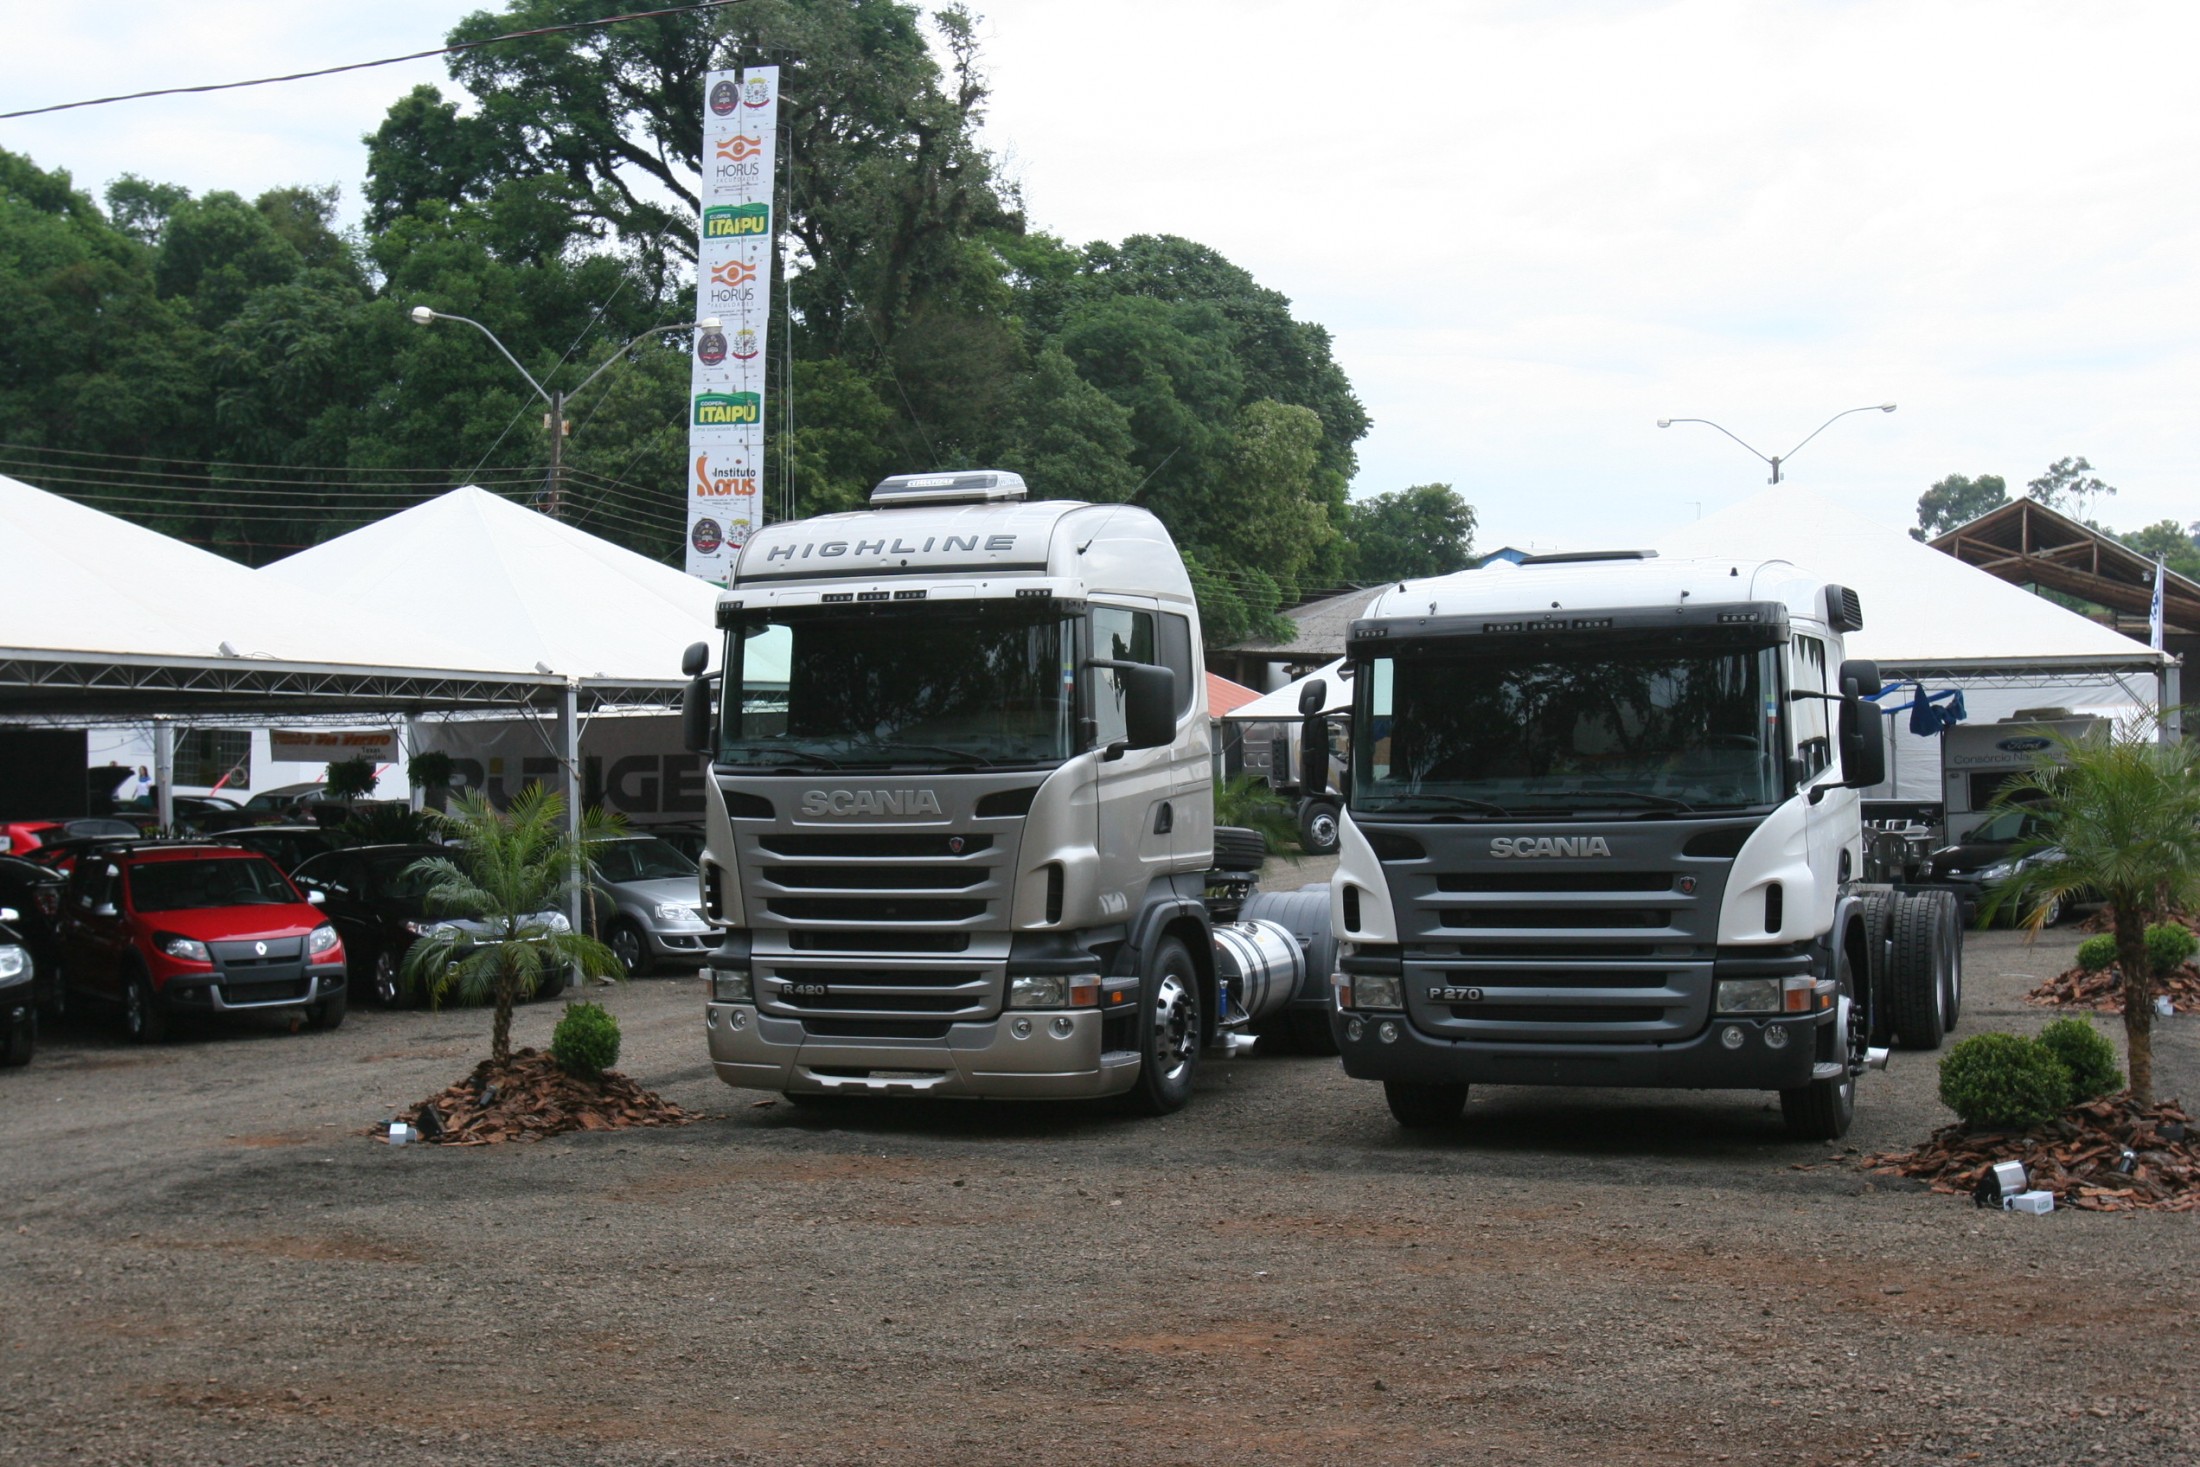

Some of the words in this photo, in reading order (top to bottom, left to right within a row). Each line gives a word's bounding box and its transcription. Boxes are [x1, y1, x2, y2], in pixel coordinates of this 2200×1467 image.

[716, 162, 759, 177] HORUS
[708, 215, 765, 236] ITAIPU
[711, 287, 754, 302] HORUS
[699, 404, 756, 423] ITAIPU
[713, 467, 756, 478] Instituto
[767, 534, 1017, 562] HIGHLINE
[1953, 752, 2011, 765] Consórcio
[801, 789, 942, 817] SCANIA
[1489, 836, 1612, 858] SCANIA
[783, 984, 794, 994] R
[795, 984, 825, 995] 420
[1429, 987, 1441, 999] P
[1443, 988, 1480, 1000] 270
